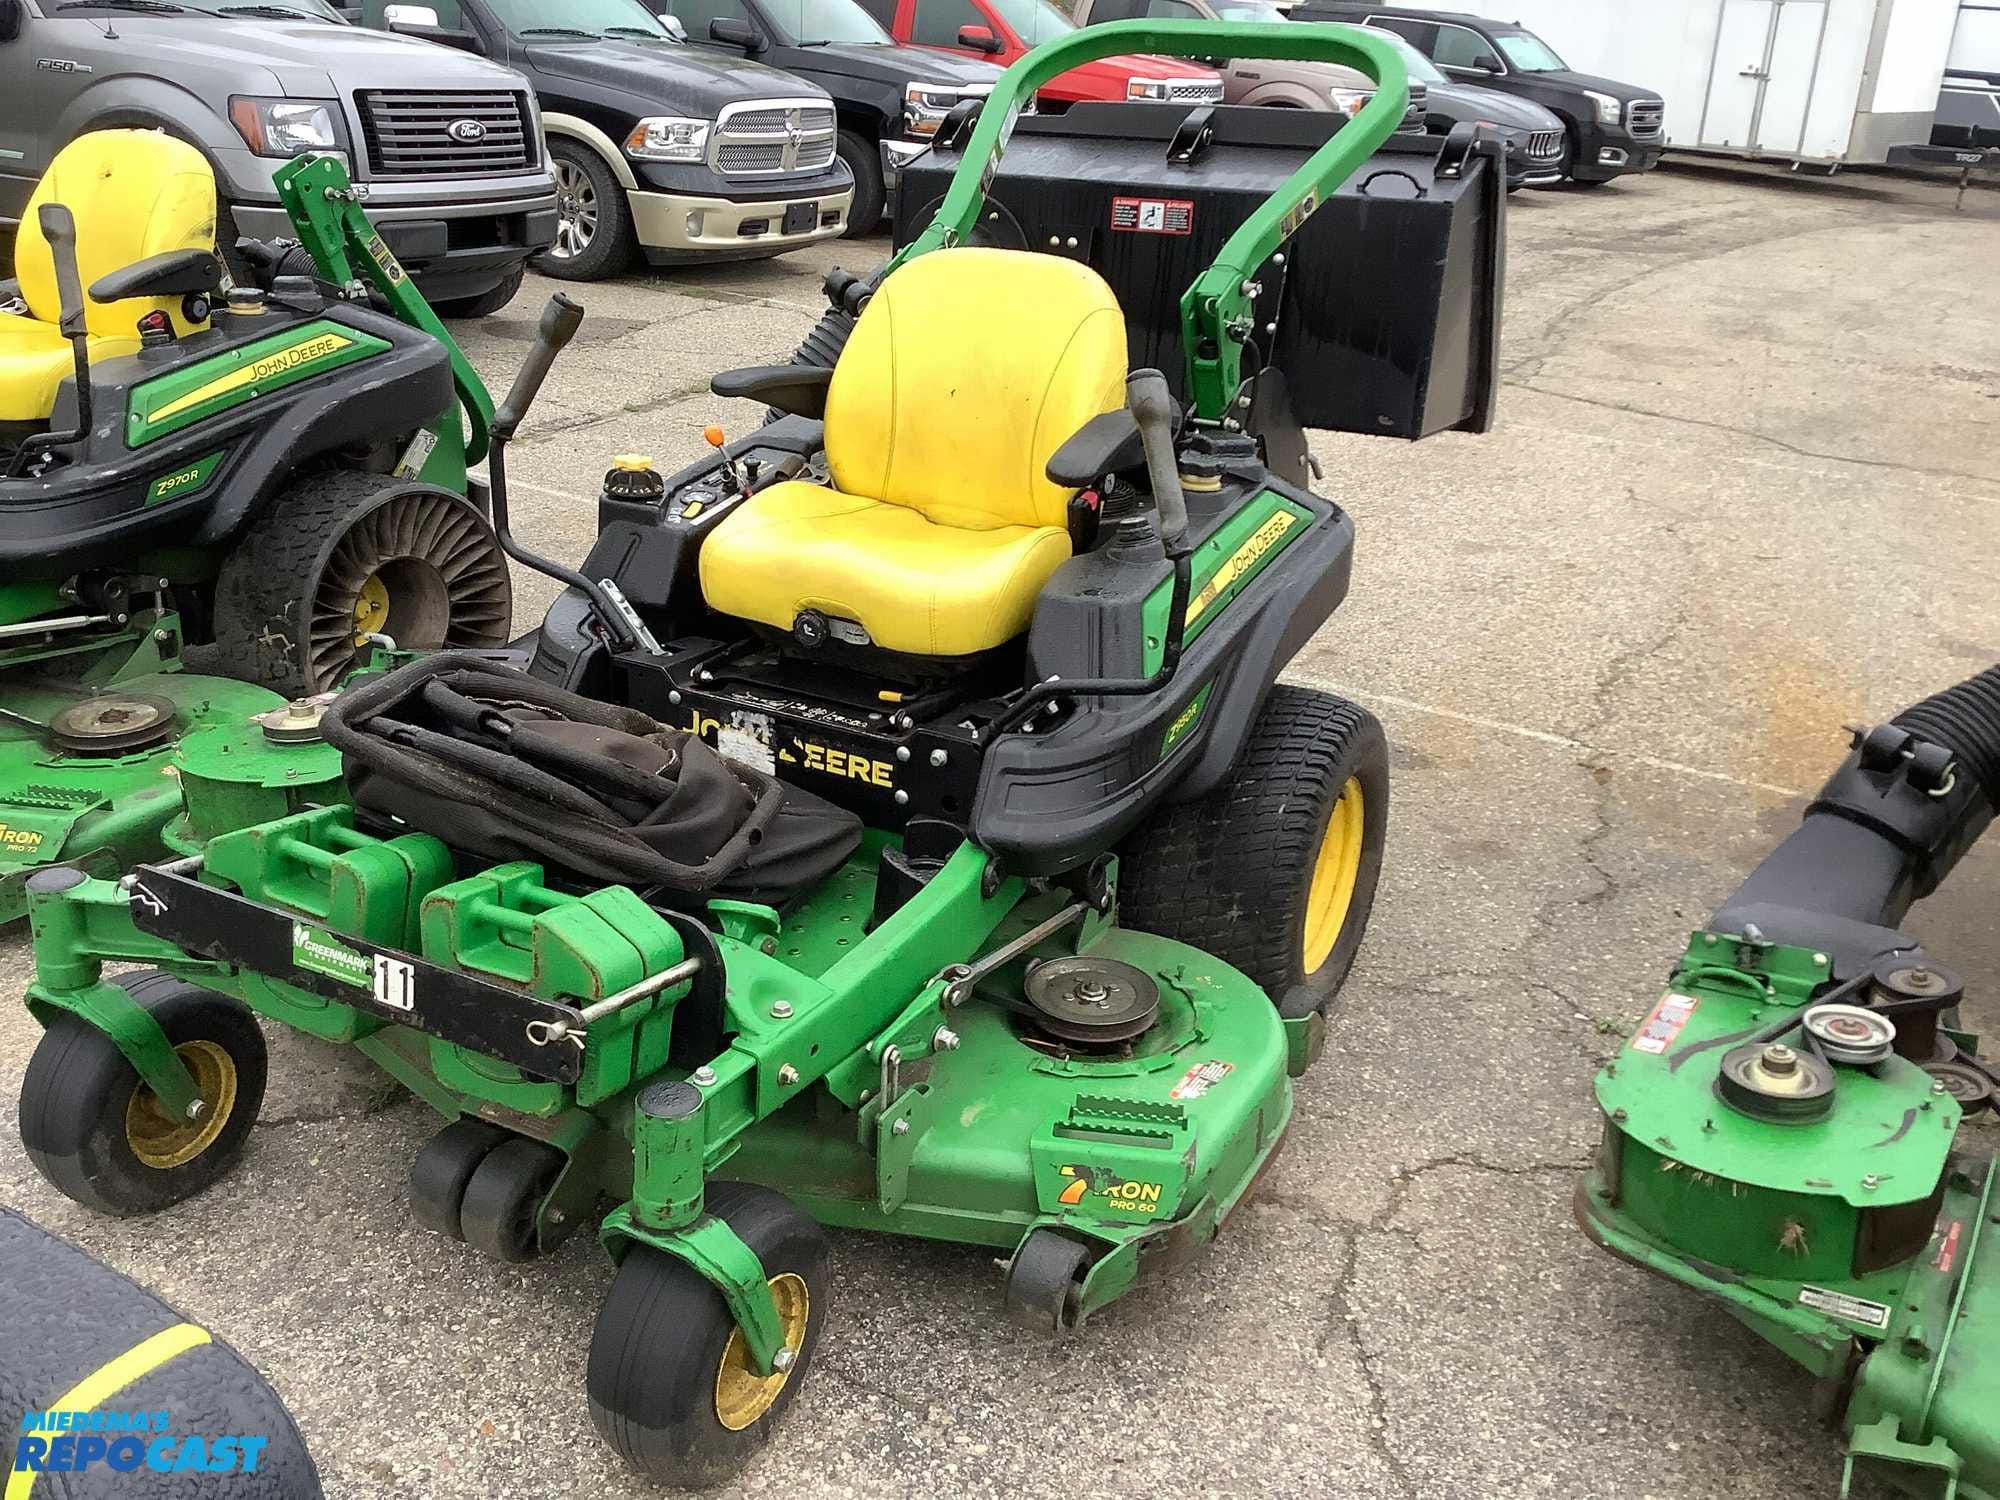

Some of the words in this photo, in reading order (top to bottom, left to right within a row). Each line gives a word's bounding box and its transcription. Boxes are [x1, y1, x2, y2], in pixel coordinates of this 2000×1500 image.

[460, 123, 481, 137] Ford
[250, 356, 288, 381] JOHN
[289, 339, 335, 364] DEERE
[156, 469, 199, 496] Z970R
[1231, 548, 1257, 578] JOHN
[1256, 517, 1286, 552] DEERE
[7, 844, 25, 852] PRO
[304, 941, 368, 971] GREENMARK
[380, 960, 408, 1007] 11
[1109, 1200, 1136, 1211] PRO
[1138, 1203, 1157, 1213] 60
